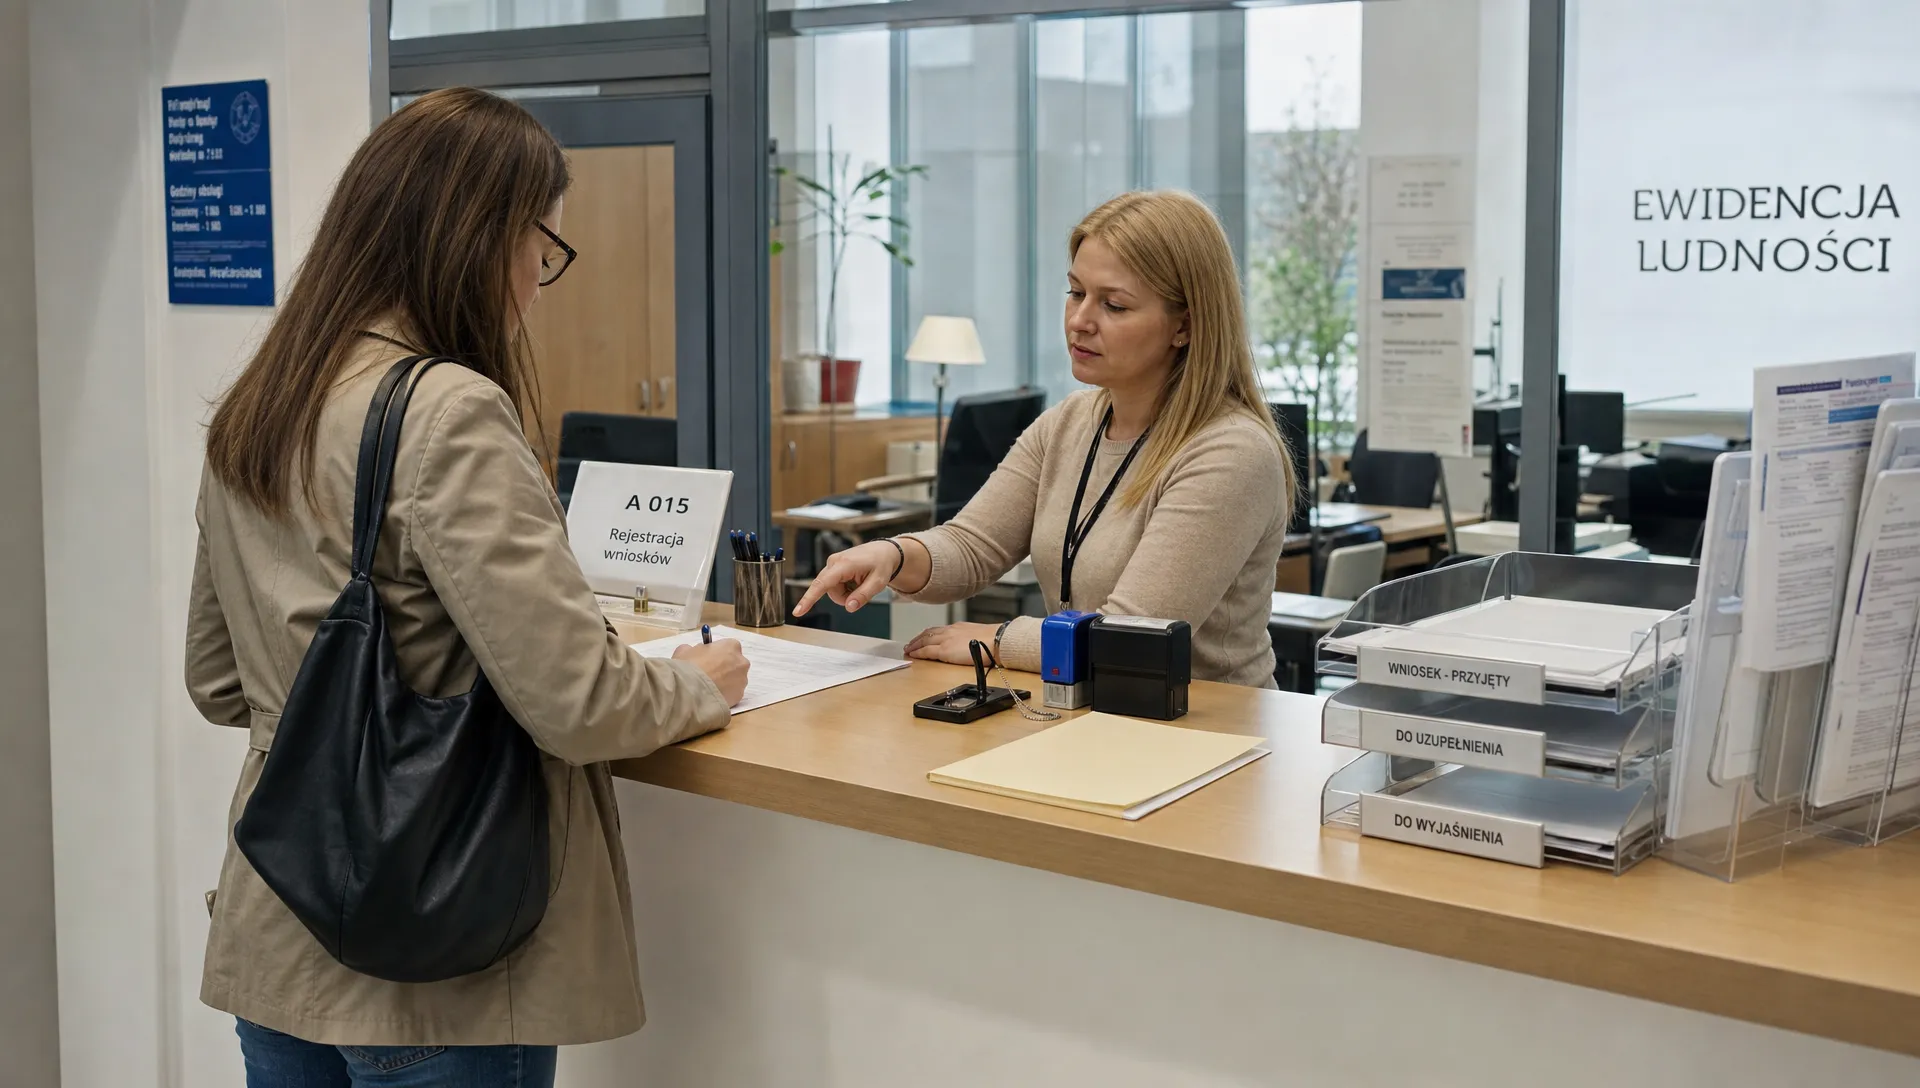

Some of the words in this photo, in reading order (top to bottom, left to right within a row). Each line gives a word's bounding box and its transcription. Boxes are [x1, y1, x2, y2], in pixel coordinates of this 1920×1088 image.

[1633, 183, 1901, 222] EWIDENCJA
[1637, 229, 1892, 273] LUDNOŚCI
[624, 494, 641, 511] A
[648, 495, 690, 514] 015
[609, 527, 684, 549] Rejestracja
[604, 548, 672, 566] wniosków
[1388, 661, 1442, 680] WNIOSEK
[1451, 669, 1511, 690] PRZYJĘTY
[1396, 728, 1413, 743] DO
[1416, 732, 1504, 757] UZUPEŁNIENIA
[1394, 813, 1413, 829] DO
[1415, 817, 1504, 846] WYJAŚNIENIA
